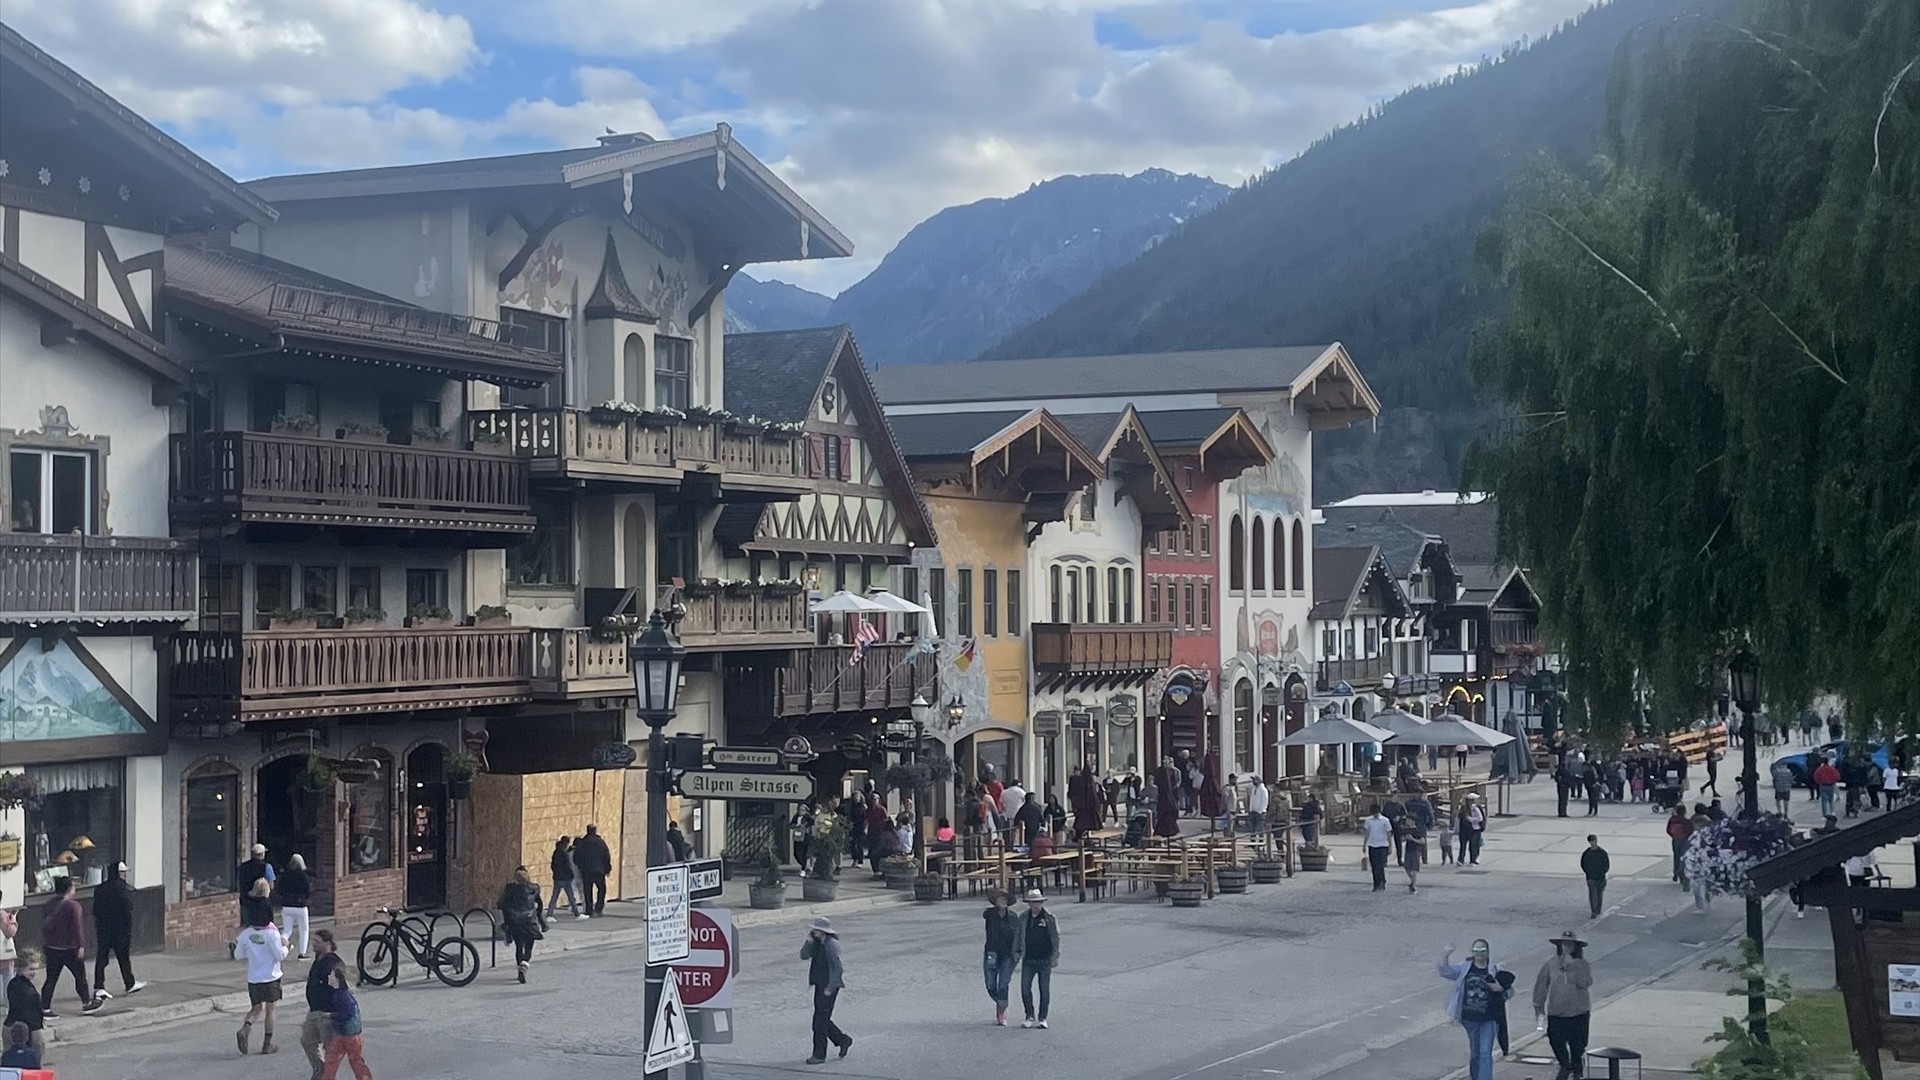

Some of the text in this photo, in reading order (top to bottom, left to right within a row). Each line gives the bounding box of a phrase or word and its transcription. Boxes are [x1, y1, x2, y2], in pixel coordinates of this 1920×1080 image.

[736, 753, 772, 763] Street
[692, 775, 799, 794] Alpen Strasse
[658, 872, 678, 883] WINTER
[703, 871, 718, 886] WAY
[656, 883, 680, 894] PARKING
[690, 927, 718, 942] NOT
[673, 971, 712, 987] NTER
